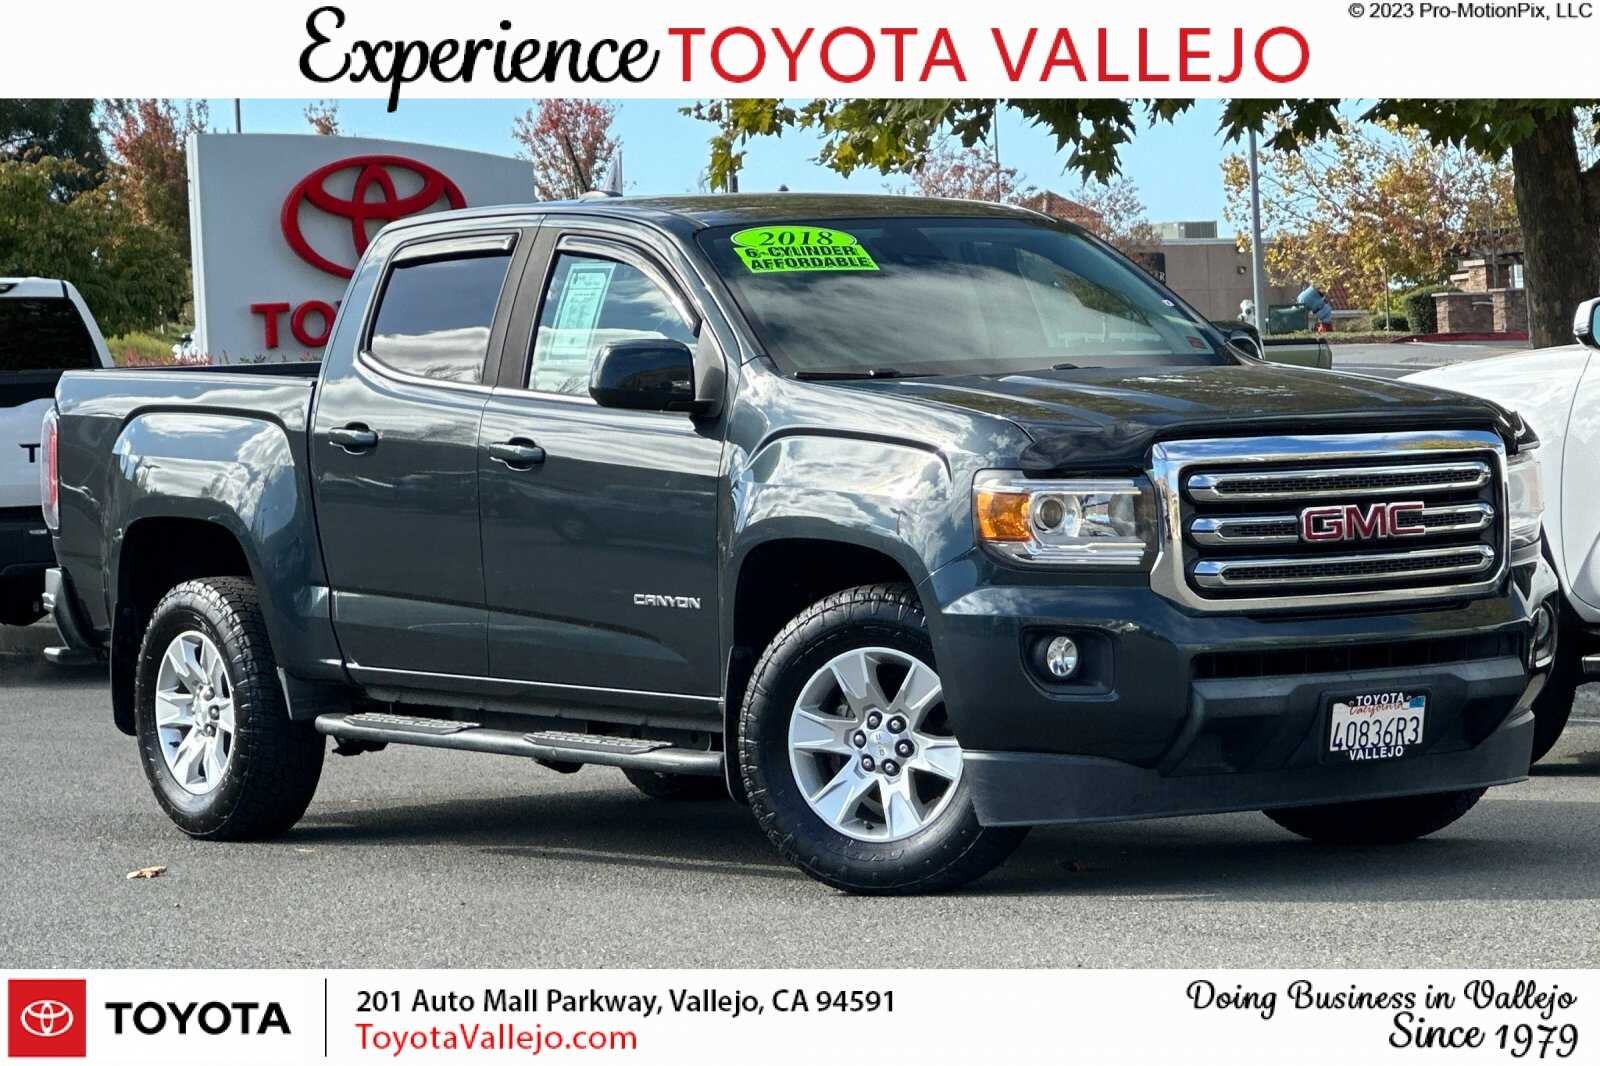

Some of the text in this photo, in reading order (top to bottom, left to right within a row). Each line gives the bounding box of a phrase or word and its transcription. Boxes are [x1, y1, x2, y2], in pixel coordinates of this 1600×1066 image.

[758, 231, 834, 246] 2018
[751, 256, 874, 270] AFFORDABLE
[250, 300, 342, 350] TO
[1301, 501, 1426, 541] GMC
[633, 593, 701, 609] CANYON
[1356, 692, 1405, 707] TOYOTA
[1332, 716, 1420, 749] 40836R3
[1349, 745, 1404, 761] VALLEJO
